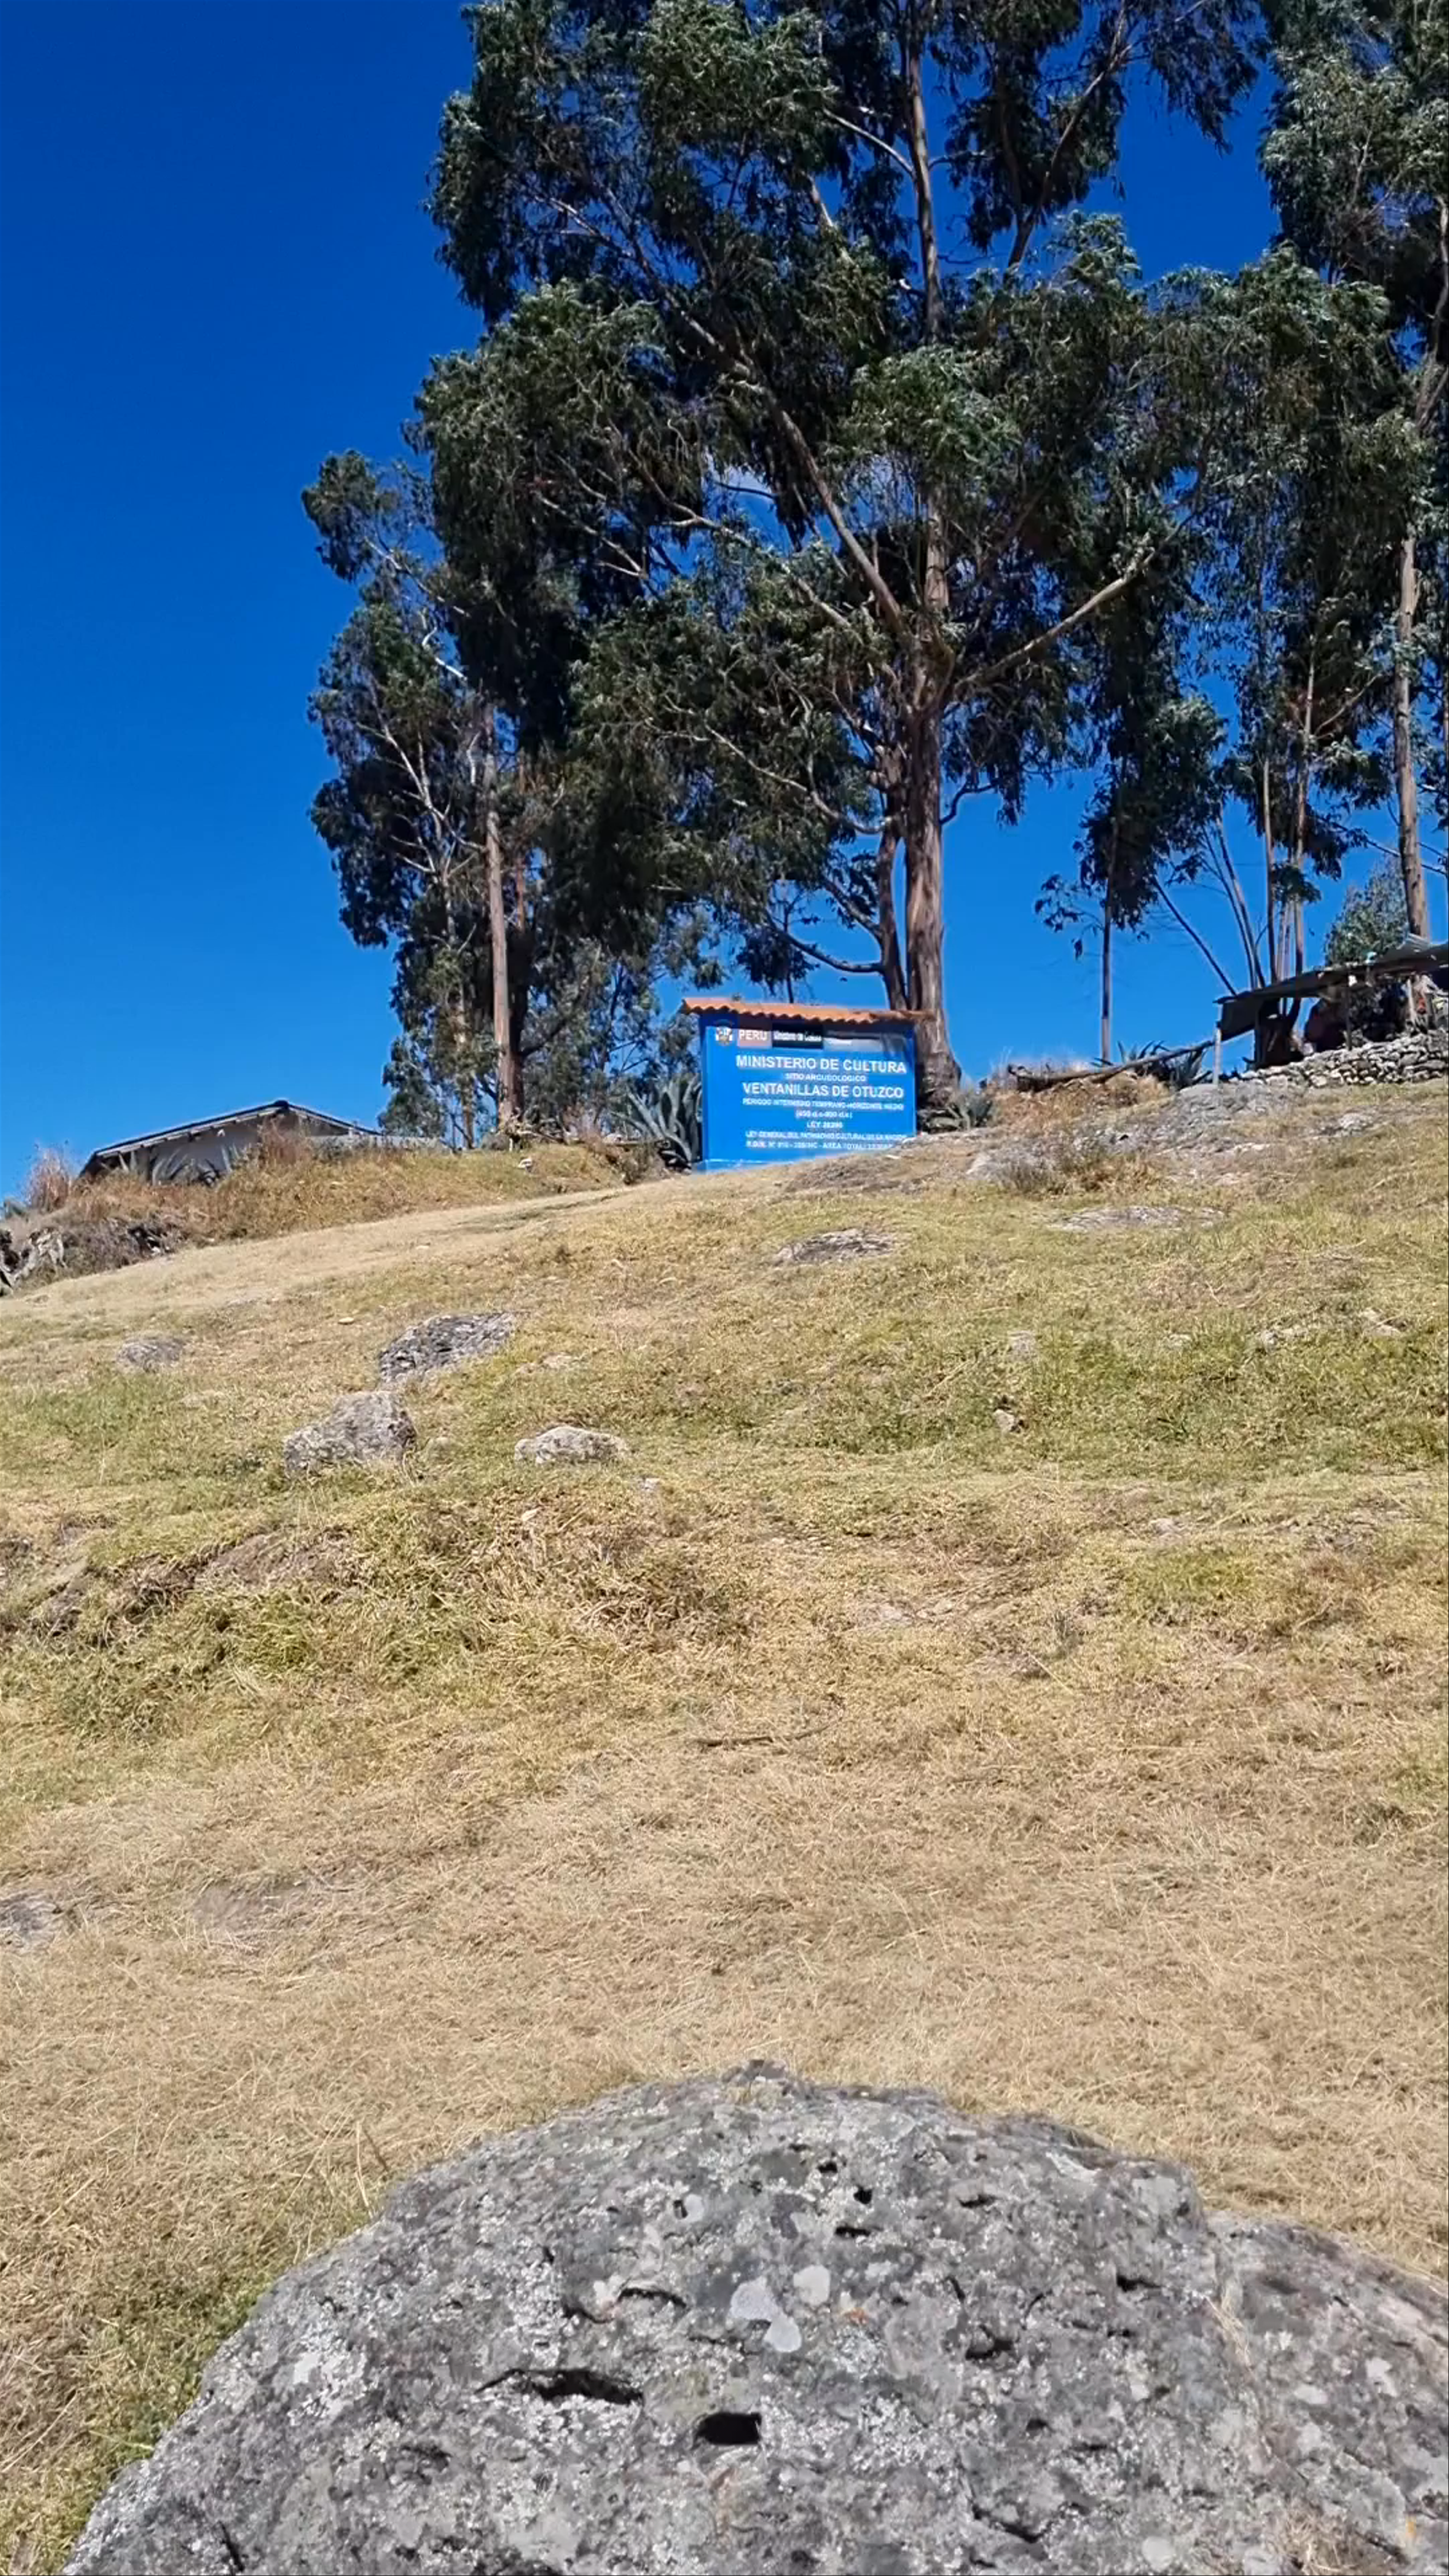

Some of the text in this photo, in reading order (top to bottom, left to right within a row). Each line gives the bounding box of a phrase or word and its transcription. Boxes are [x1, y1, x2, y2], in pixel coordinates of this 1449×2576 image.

[737, 1055, 907, 1073] MINISTERIO DE CULTURA
[743, 1083, 903, 1098] VENTANILLAS DE OTUZCO
